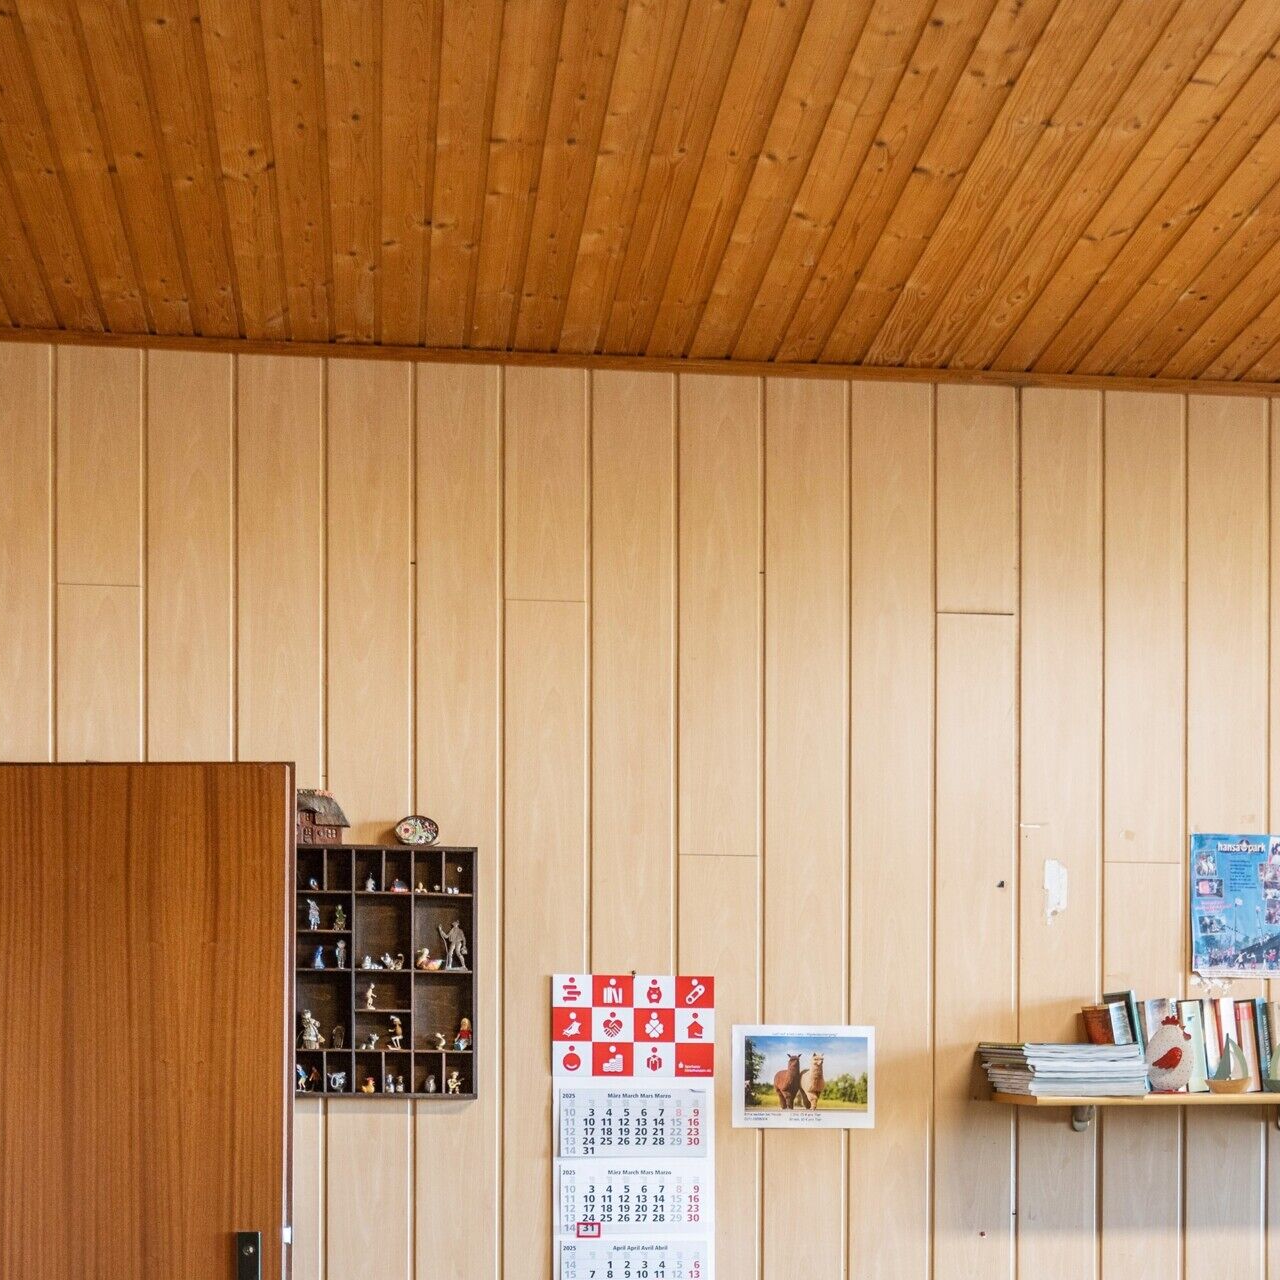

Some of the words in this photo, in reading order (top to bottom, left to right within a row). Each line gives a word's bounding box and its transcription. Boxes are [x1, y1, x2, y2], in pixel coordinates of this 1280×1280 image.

[1217, 843, 1241, 852] hansa
[1247, 844, 1265, 854] park
[589, 1108, 595, 1116] 3
[606, 1108, 612, 1116] 4
[624, 1108, 630, 1117] 5
[641, 1108, 647, 1117] 6
[693, 1109, 699, 1117] 9
[583, 1118, 595, 1126] 10
[601, 1118, 611, 1126] 11
[618, 1118, 629, 1126] 12
[636, 1118, 647, 1126] 13
[653, 1118, 665, 1126] 14
[688, 1118, 699, 1126] 16
[584, 1127, 595, 1135] 17
[601, 1127, 612, 1136] 18
[618, 1128, 630, 1136] 19
[635, 1127, 647, 1136] 20
[653, 1128, 664, 1136] 21
[687, 1128, 699, 1136] 23
[583, 1137, 595, 1145] 24
[600, 1137, 612, 1145] 25
[618, 1137, 630, 1145] 26
[635, 1137, 647, 1145] 27
[652, 1137, 665, 1145] 28
[687, 1137, 700, 1145] 30
[583, 1147, 594, 1155] 31
[589, 1185, 595, 1193] 3
[606, 1185, 612, 1193] 4
[624, 1185, 630, 1193] 5
[641, 1185, 647, 1193] 6
[659, 1185, 664, 1193] 7
[584, 1195, 595, 1203] 10
[601, 1195, 612, 1203] 11
[619, 1195, 630, 1203] 12
[636, 1194, 647, 1203] 13
[653, 1195, 665, 1203] 14
[584, 1204, 595, 1212] 17
[601, 1204, 613, 1213] 18
[618, 1204, 630, 1212] 19
[635, 1204, 647, 1212] 20
[653, 1204, 664, 1212] 21
[583, 1214, 595, 1222] 24
[600, 1214, 613, 1222] 25
[618, 1214, 630, 1222] 26
[635, 1214, 647, 1222] 27
[652, 1214, 665, 1222] 28
[608, 1261, 612, 1269] 1
[624, 1261, 630, 1269] 2
[642, 1260, 648, 1269] 3
[694, 1261, 700, 1269] 6
[590, 1270, 595, 1278] 7
[607, 1270, 613, 1278] 8
[624, 1270, 631, 1278] 9
[636, 1270, 648, 1278] 10
[654, 1270, 664, 1278] 11
[689, 1270, 700, 1278] 13
